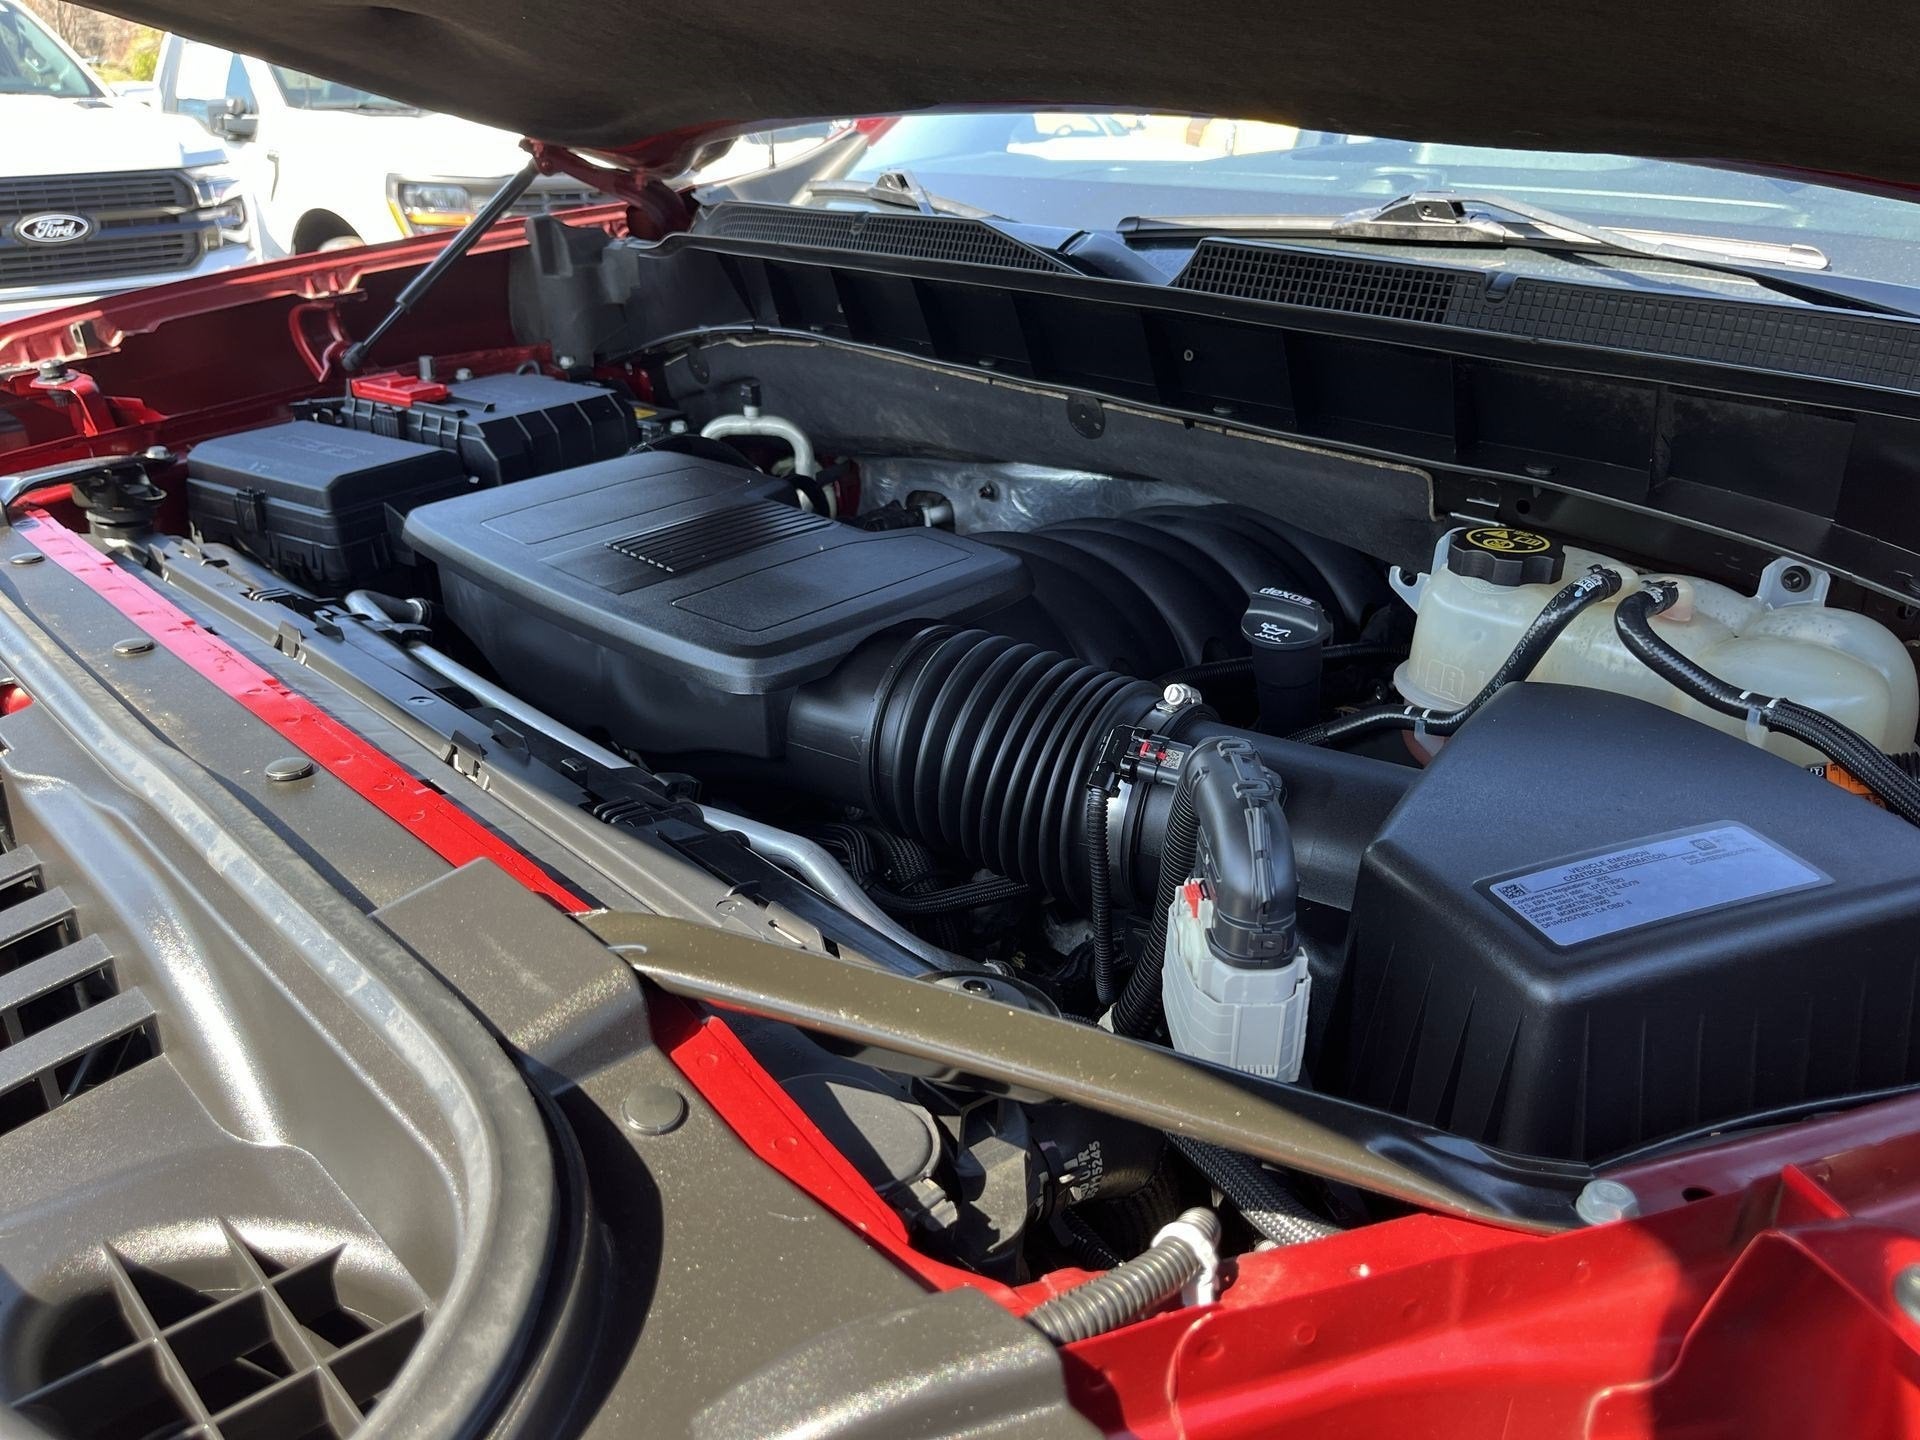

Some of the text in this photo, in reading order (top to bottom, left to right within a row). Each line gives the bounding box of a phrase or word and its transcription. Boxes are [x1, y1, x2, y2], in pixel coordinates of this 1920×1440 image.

[34, 219, 76, 238] Ford
[1260, 587, 1316, 606] dexos
[1562, 867, 1607, 881] CONTROL
[1605, 852, 1667, 870] INFORMATION
[1568, 850, 1650, 873] VEHICLE EMISSION
